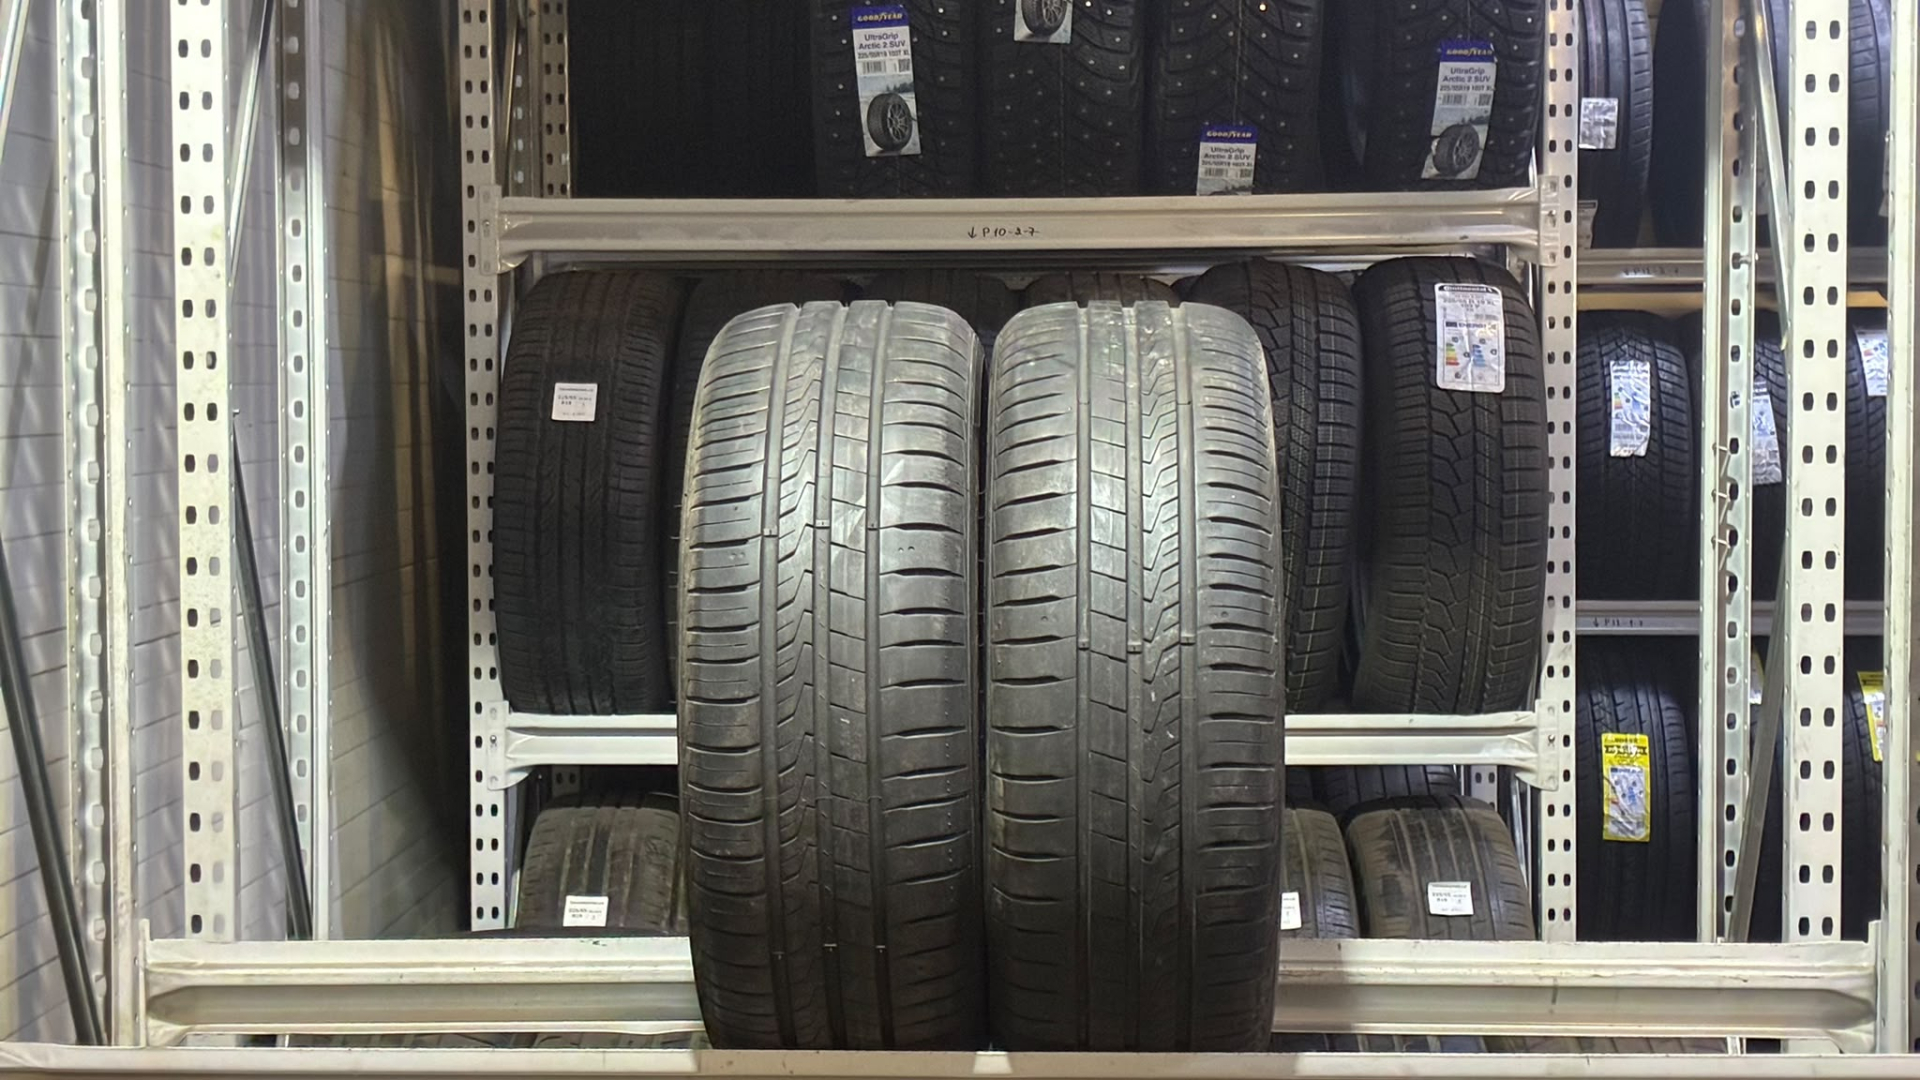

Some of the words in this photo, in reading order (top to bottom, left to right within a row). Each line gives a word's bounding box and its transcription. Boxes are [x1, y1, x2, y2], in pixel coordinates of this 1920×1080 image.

[857, 12, 903, 22] GOODYEAR
[864, 33, 898, 41] UltraGrip
[890, 40, 906, 48] SUV
[1446, 47, 1493, 56] GOODYEAR
[1450, 67, 1485, 75] UltraGrip
